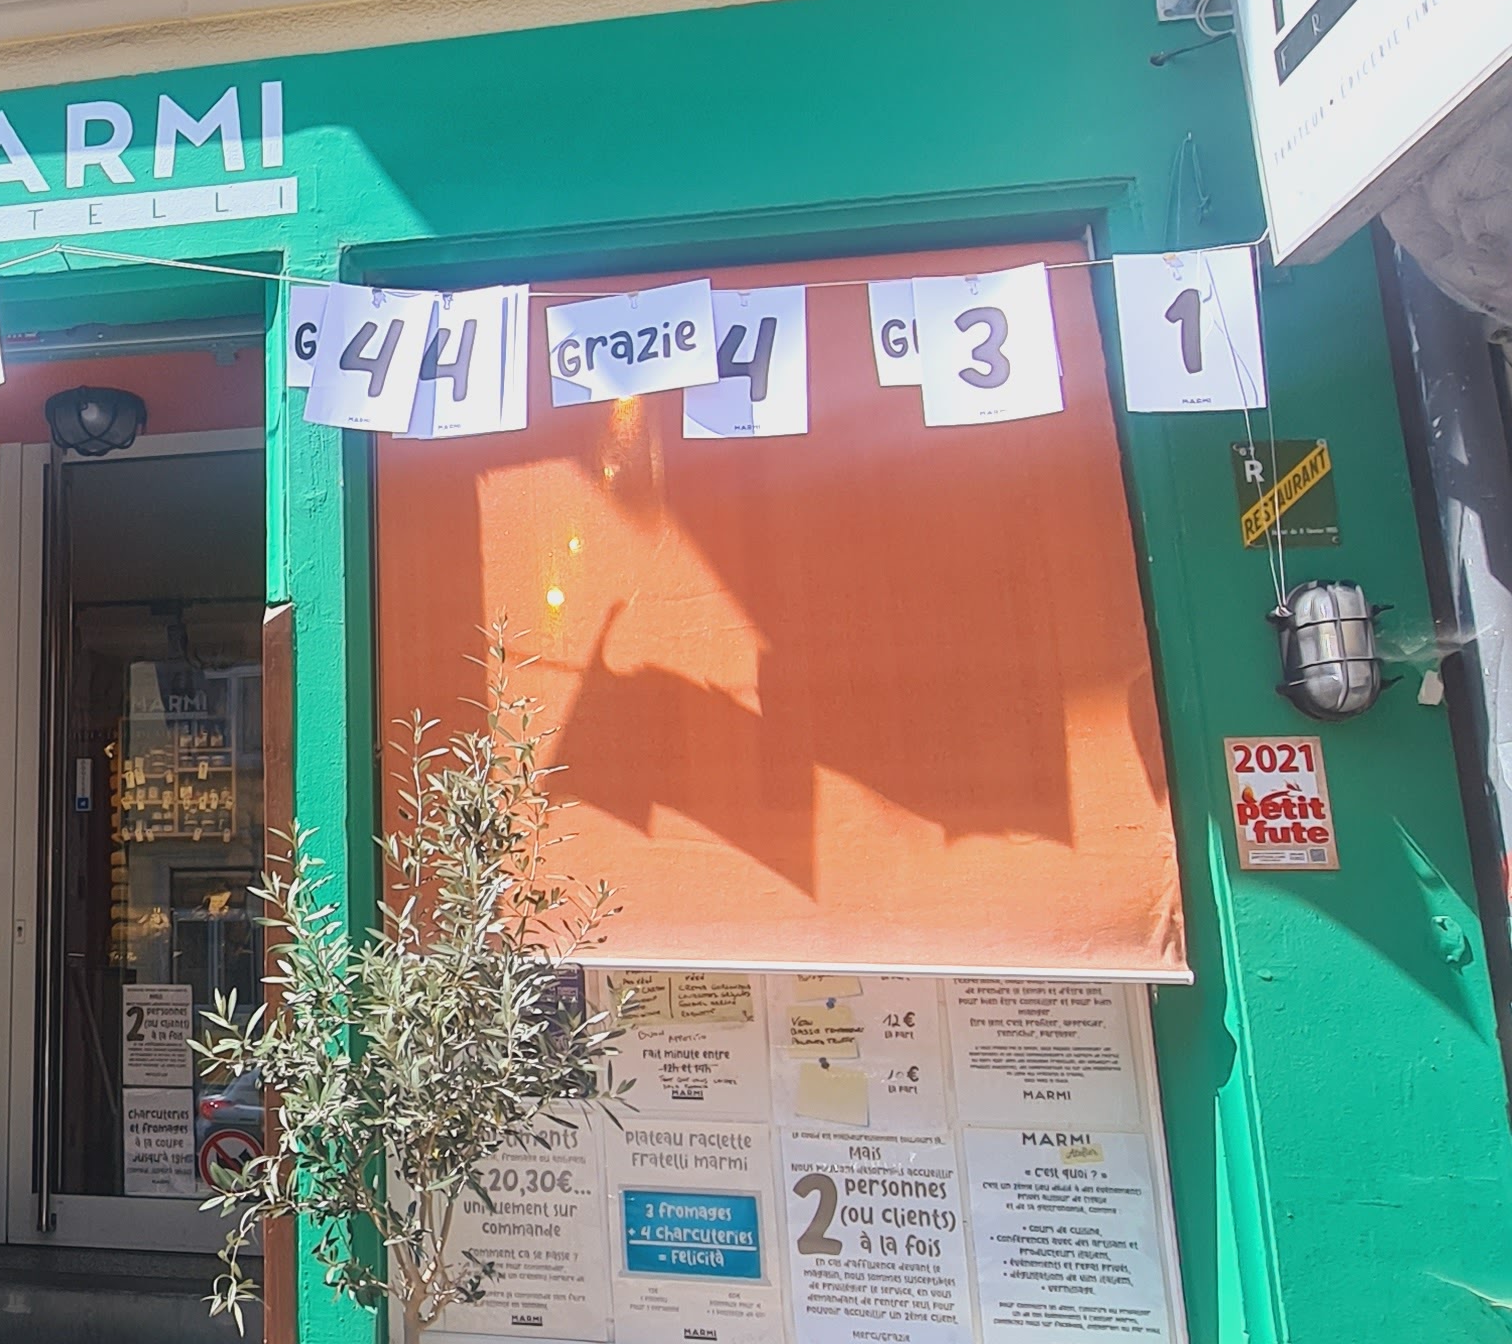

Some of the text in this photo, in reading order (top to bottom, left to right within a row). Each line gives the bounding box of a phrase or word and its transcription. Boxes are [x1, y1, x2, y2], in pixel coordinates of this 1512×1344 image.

[1164, 288, 1204, 374] 1
[557, 320, 697, 377] Grazie
[954, 306, 1011, 389] 3
[340, 318, 405, 398] 4
[419, 319, 477, 402] 4
[718, 316, 778, 402] 4
[1244, 460, 1265, 482] R
[1245, 448, 1326, 540] RESTAURANT
[1233, 744, 1314, 773] 2021
[1237, 796, 1326, 825] petit
[126, 1007, 145, 1041] 2
[664, 1050, 700, 1061] minute
[703, 1050, 730, 1061] entre
[1023, 1090, 1072, 1100] MARMI
[128, 1109, 189, 1121] charcuteries
[142, 1122, 189, 1134] fromages
[155, 1138, 184, 1148] coupe
[689, 1133, 752, 1150] raclette
[1021, 1132, 1091, 1147] MARMI
[632, 1152, 748, 1171] Fratelli marmi
[849, 1146, 881, 1161] Mais
[791, 1163, 954, 1179] Nous accueillir
[1034, 1167, 1098, 1180] C'est quoi ?
[553, 1204, 578, 1218] sur
[645, 1201, 732, 1222] 3 fromages
[792, 1173, 947, 1256] 2 personnes
[840, 1205, 956, 1233] (ou clients)
[482, 1221, 561, 1238] commande
[641, 1226, 650, 1240] 4
[656, 1226, 753, 1246] charcuteries
[860, 1230, 941, 1257] à la fois
[844, 1271, 865, 1280] nous
[684, 1328, 717, 1337] MARMI
